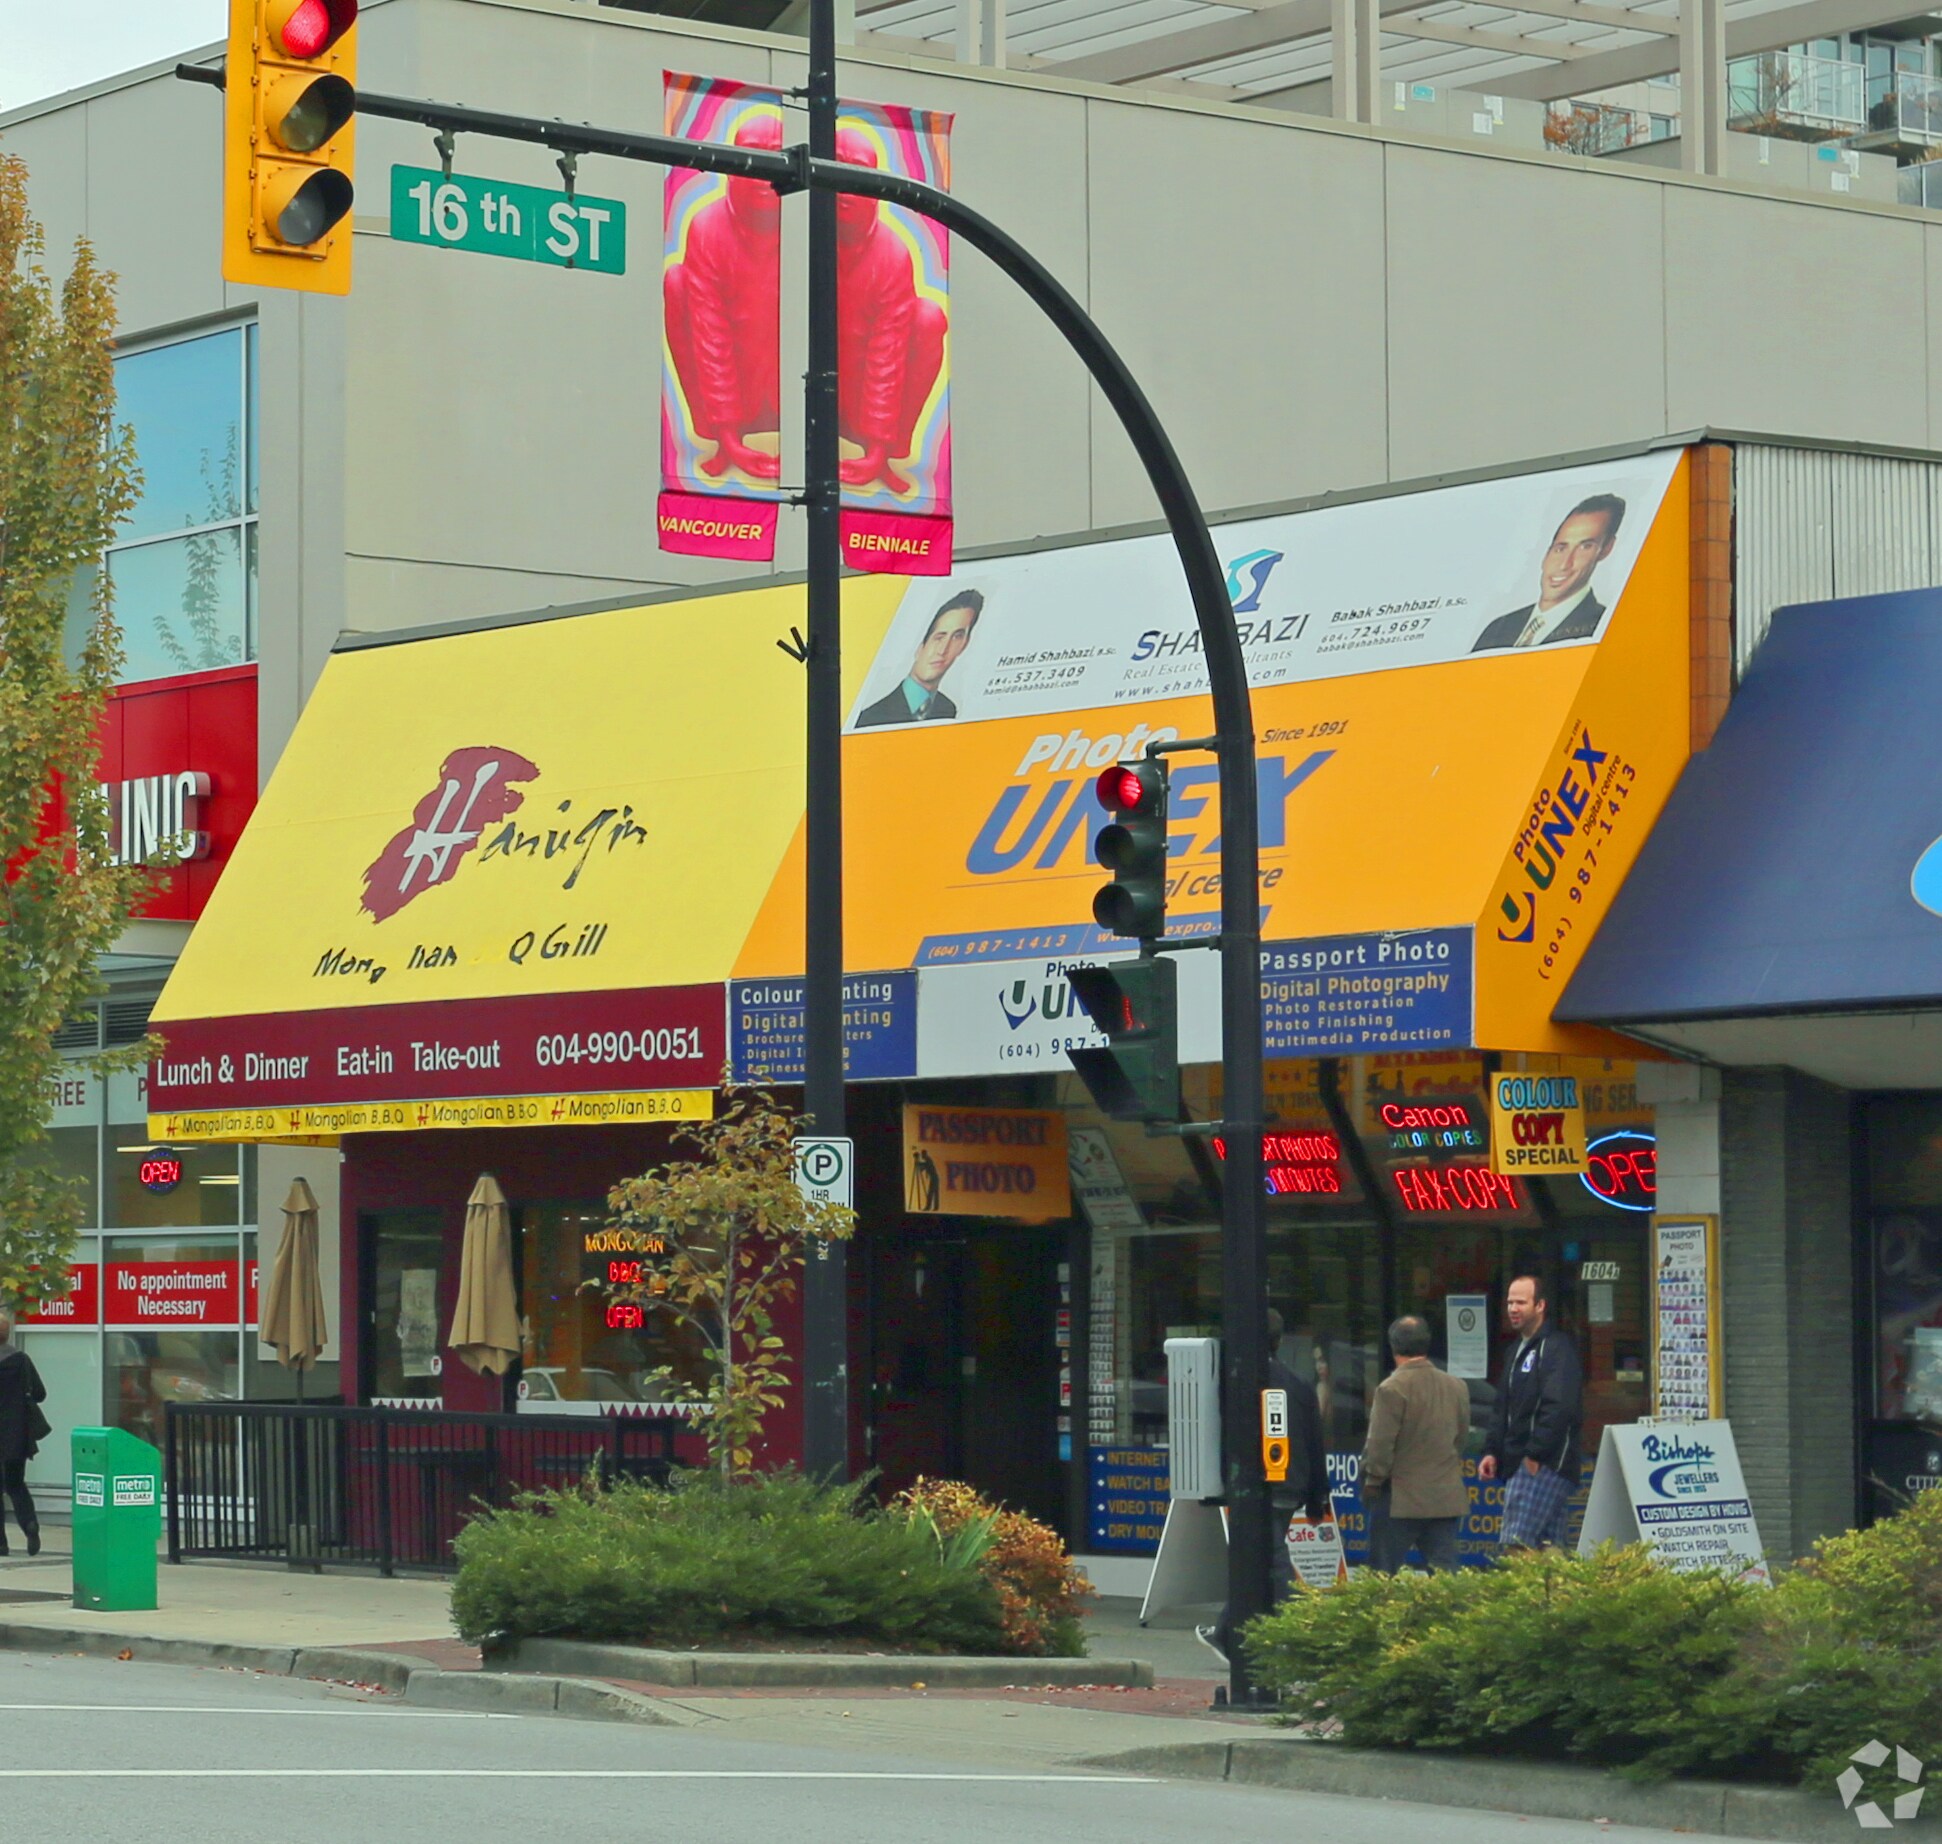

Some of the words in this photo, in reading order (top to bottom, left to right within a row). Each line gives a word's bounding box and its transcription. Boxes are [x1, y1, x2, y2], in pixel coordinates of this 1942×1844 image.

[409, 180, 468, 241] 16
[480, 191, 521, 236] th
[545, 201, 610, 261] ST
[659, 515, 762, 540] VANCOUVER
[849, 532, 930, 555] BIENNALE
[1331, 607, 1373, 623] Babak
[1130, 614, 1310, 661] SHABAZI
[1321, 617, 1431, 644] 604.724.9697
[1316, 633, 1425, 653] babak@shahbazi.com
[997, 652, 1037, 667] Hamid
[1123, 664, 1153, 680] Real
[1157, 661, 1202, 676] Estate
[987, 665, 1085, 687] 604.537.3409
[983, 680, 1080, 696] hamid@shahbazi.com
[1260, 726, 1304, 744] Since
[1307, 719, 1349, 739] 1991
[1582, 792, 1604, 836] Digital
[1600, 755, 1622, 796] centre
[1524, 727, 1608, 890] UNEX
[76, 770, 204, 876] LINIC
[1513, 788, 1550, 863] Photo
[1538, 917, 1572, 980] (604)
[1569, 763, 1636, 904] 987-1413
[963, 933, 1068, 955] 987-1413
[1260, 945, 1366, 971] Passport
[1378, 941, 1450, 962] Photo
[741, 986, 803, 1004] Colour
[842, 981, 892, 1001] nting
[1260, 978, 1320, 1002] Digital
[1328, 971, 1449, 995] Photography
[1265, 1002, 1310, 1016] Photo
[1318, 997, 1415, 1012] Restoration
[742, 1011, 804, 1032] Digital
[842, 1009, 892, 1027] nting
[1265, 1018, 1310, 1032] Photo
[1318, 1014, 1394, 1028] Finishing
[1265, 1035, 1354, 1048] Multimedia
[1362, 1027, 1452, 1043] Production
[157, 1056, 212, 1087] Lunch
[217, 1054, 235, 1084] &
[245, 1052, 309, 1082] Dinner
[337, 1045, 393, 1076] Eat-in
[411, 1039, 500, 1071] Take-out
[536, 1026, 704, 1066] 604-990-0051
[999, 1043, 1040, 1059] (604)
[1498, 1077, 1579, 1110] COLOUR
[182, 1116, 241, 1138] Mongolian
[305, 1110, 369, 1131] Mongolian
[432, 1103, 503, 1125] Mongolian
[569, 1095, 644, 1119] Mongolian
[1382, 1104, 1469, 1128] Canon
[918, 1110, 1052, 1146] PASSPORT
[1435, 1130, 1482, 1147] COPIES
[1512, 1112, 1566, 1146] COPY
[1505, 1147, 1580, 1166] SPECIAL
[140, 1161, 180, 1183] OPEN
[945, 1160, 1036, 1194] PHOTO
[1587, 1149, 1657, 1195] OPE
[1394, 1168, 1520, 1211] FAX-COPY
[1661, 1229, 1701, 1240] PASSPORT
[117, 1270, 136, 1290] No
[140, 1269, 227, 1295] appointment
[137, 1295, 206, 1319] Necessary
[606, 1305, 643, 1328] OPEN
[1107, 1452, 1168, 1466] INTERNET
[1641, 1434, 1716, 1471] Bishops
[1326, 1454, 1361, 1482] PHO
[1674, 1472, 1719, 1485] JEWELLERS
[117, 1479, 151, 1491] metro
[1107, 1476, 1151, 1490] WATCH
[1108, 1500, 1145, 1514] VIDEO
[1641, 1507, 1678, 1520] CUSTOM
[1678, 1506, 1710, 1519] DESIGN
[1710, 1504, 1721, 1517] BY
[1108, 1524, 1132, 1538] DRY
[1287, 1528, 1315, 1542] Cafe
[1657, 1526, 1711, 1538] GOLDSMITH
[1713, 1524, 1726, 1535] ON
[1728, 1523, 1749, 1534] SITE
[1661, 1541, 1694, 1553] WATCH
[1695, 1540, 1729, 1551] REPAIR
